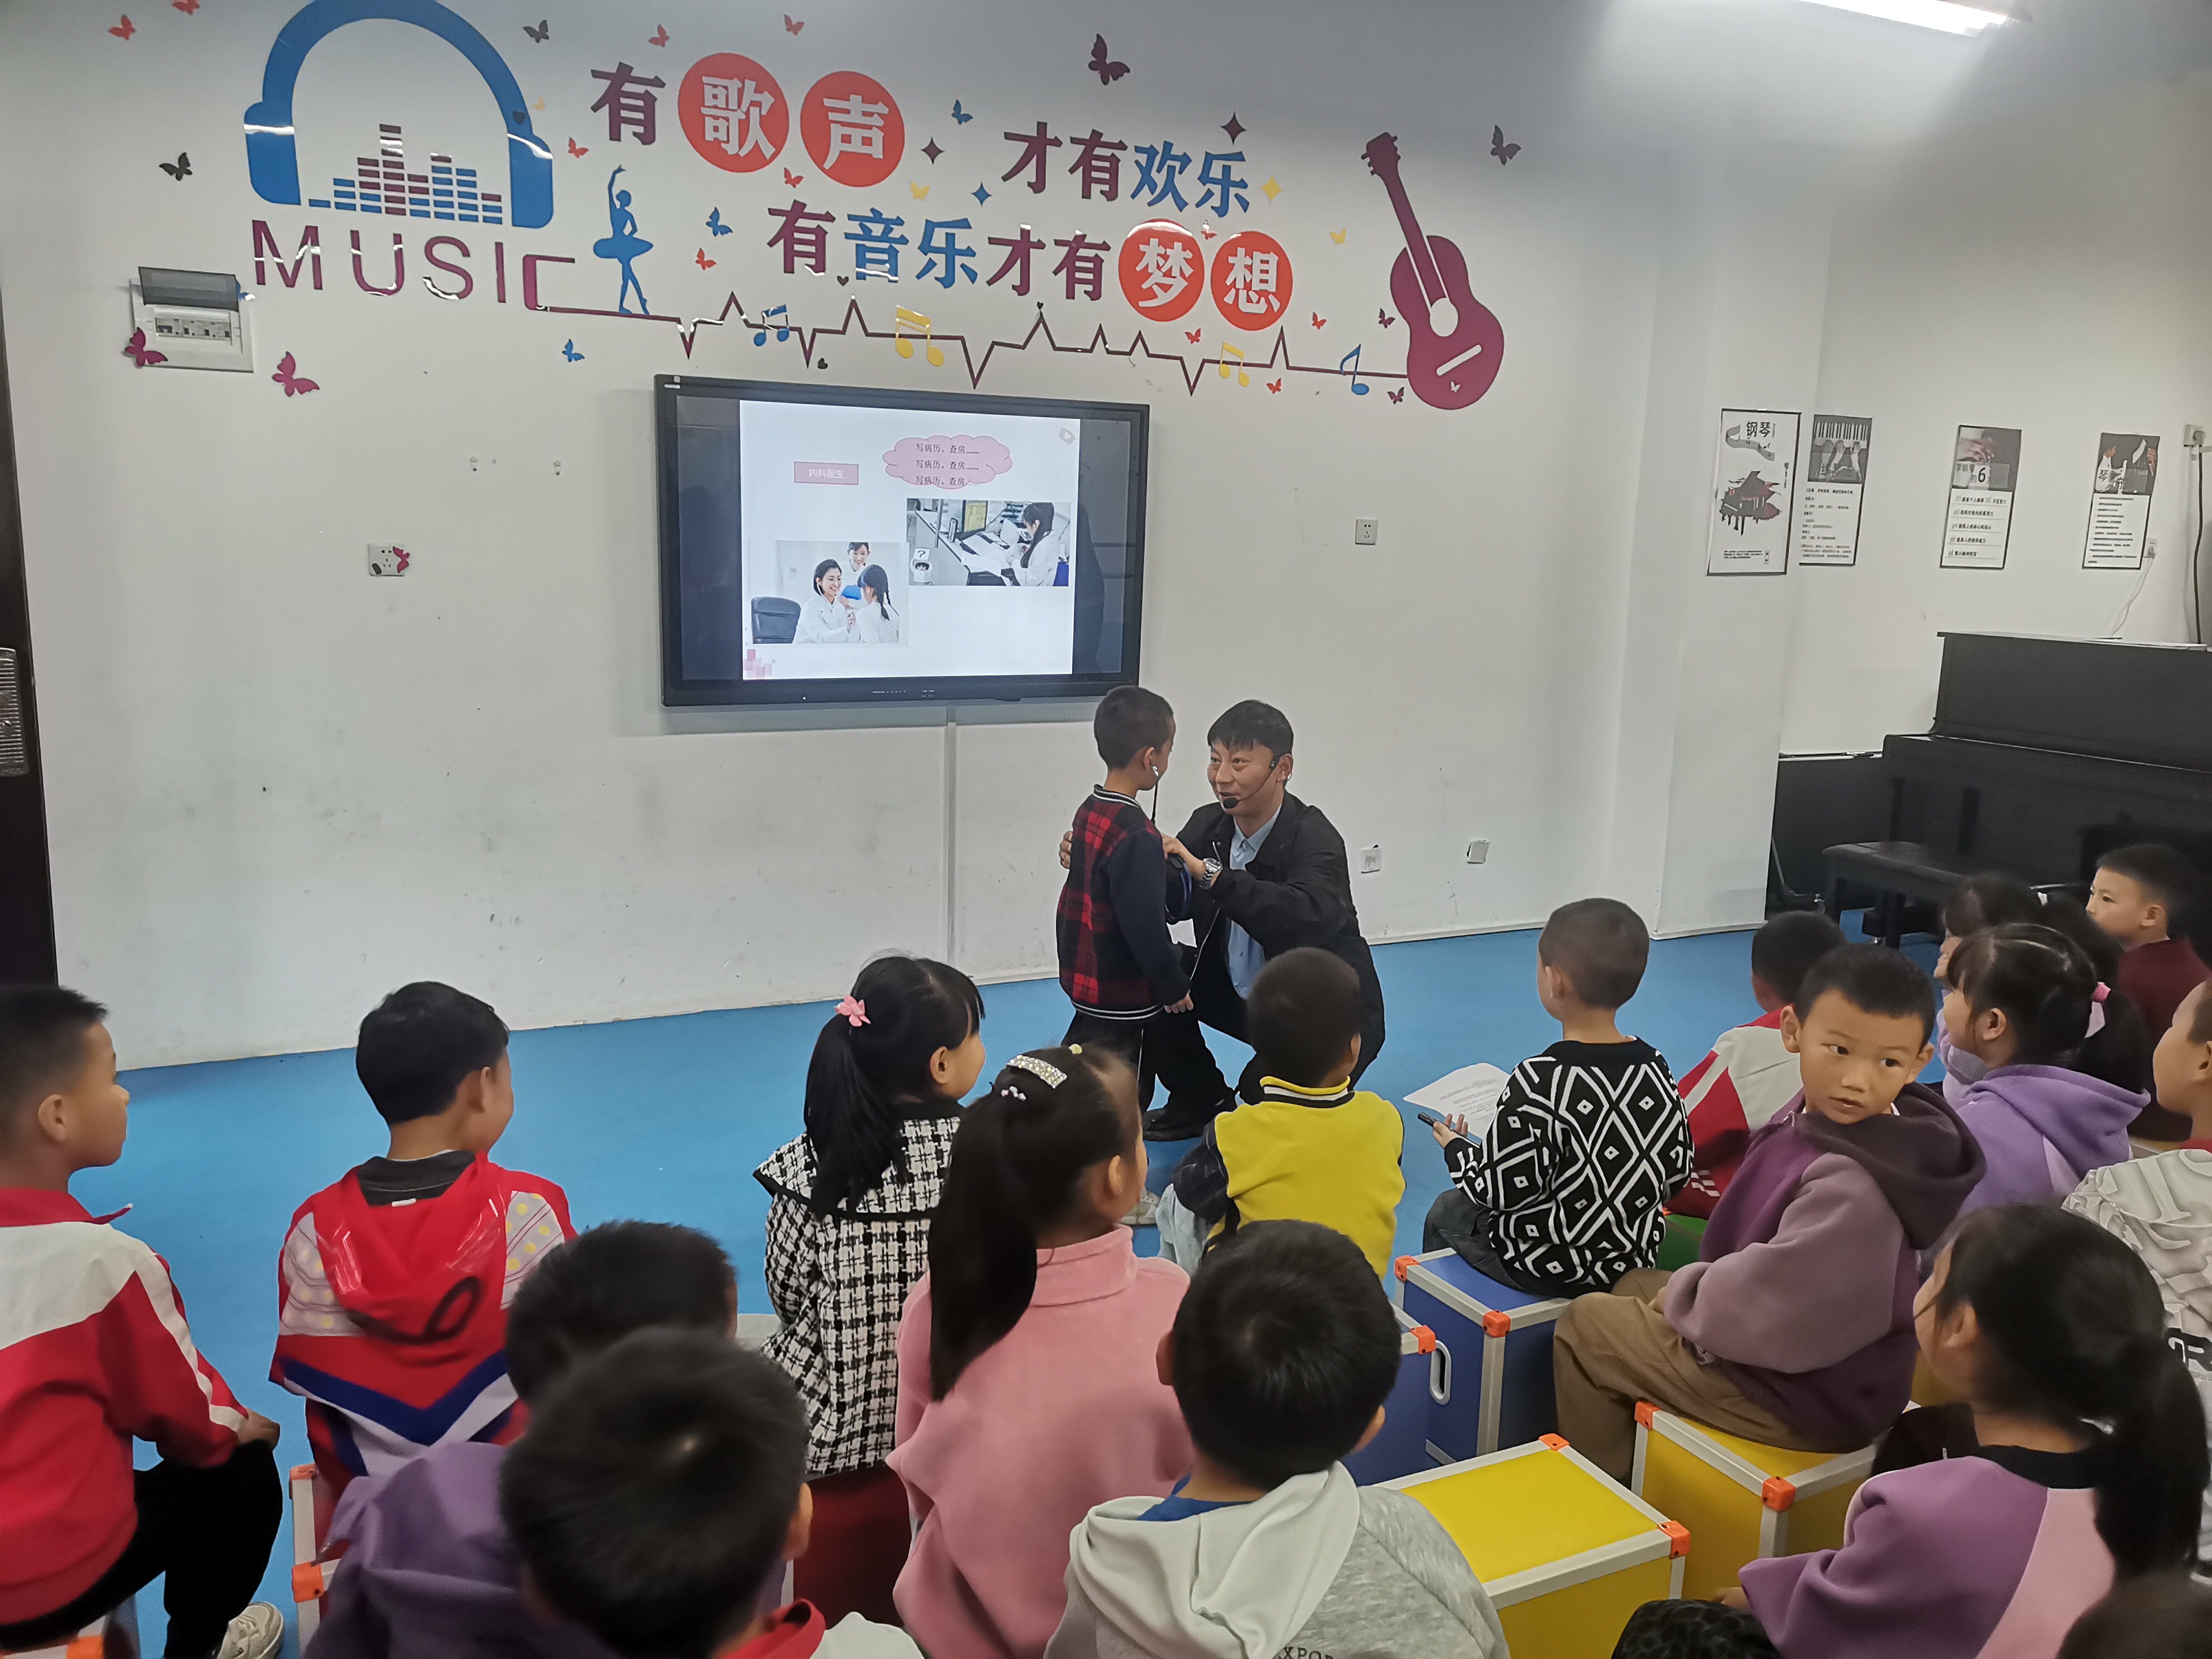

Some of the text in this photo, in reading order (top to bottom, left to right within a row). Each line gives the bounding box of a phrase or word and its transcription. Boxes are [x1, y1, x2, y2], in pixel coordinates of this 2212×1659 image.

[590, 61, 1251, 218] 有歌声 才有欢乐
[766, 199, 1281, 314] 有音乐才有梦想
[1746, 420, 1771, 437] 钢琴
